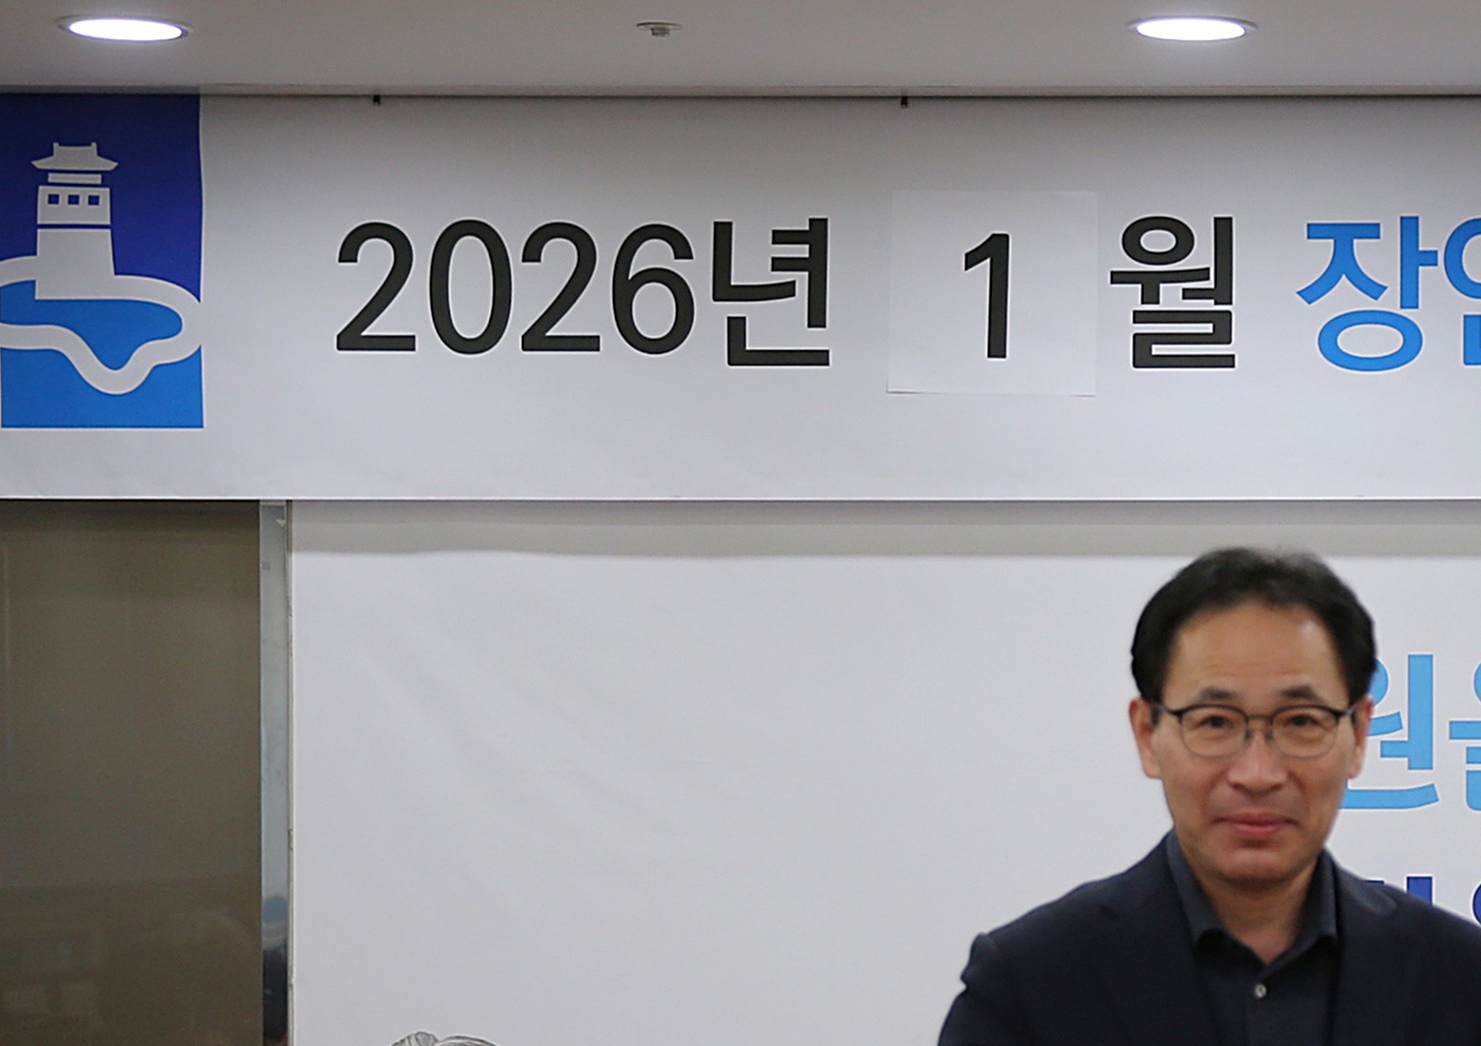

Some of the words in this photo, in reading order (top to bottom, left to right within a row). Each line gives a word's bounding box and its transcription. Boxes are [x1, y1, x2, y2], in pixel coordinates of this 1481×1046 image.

[335, 217, 831, 367] 2026년
[963, 233, 1011, 360] 1
[1109, 216, 1238, 369] 월
